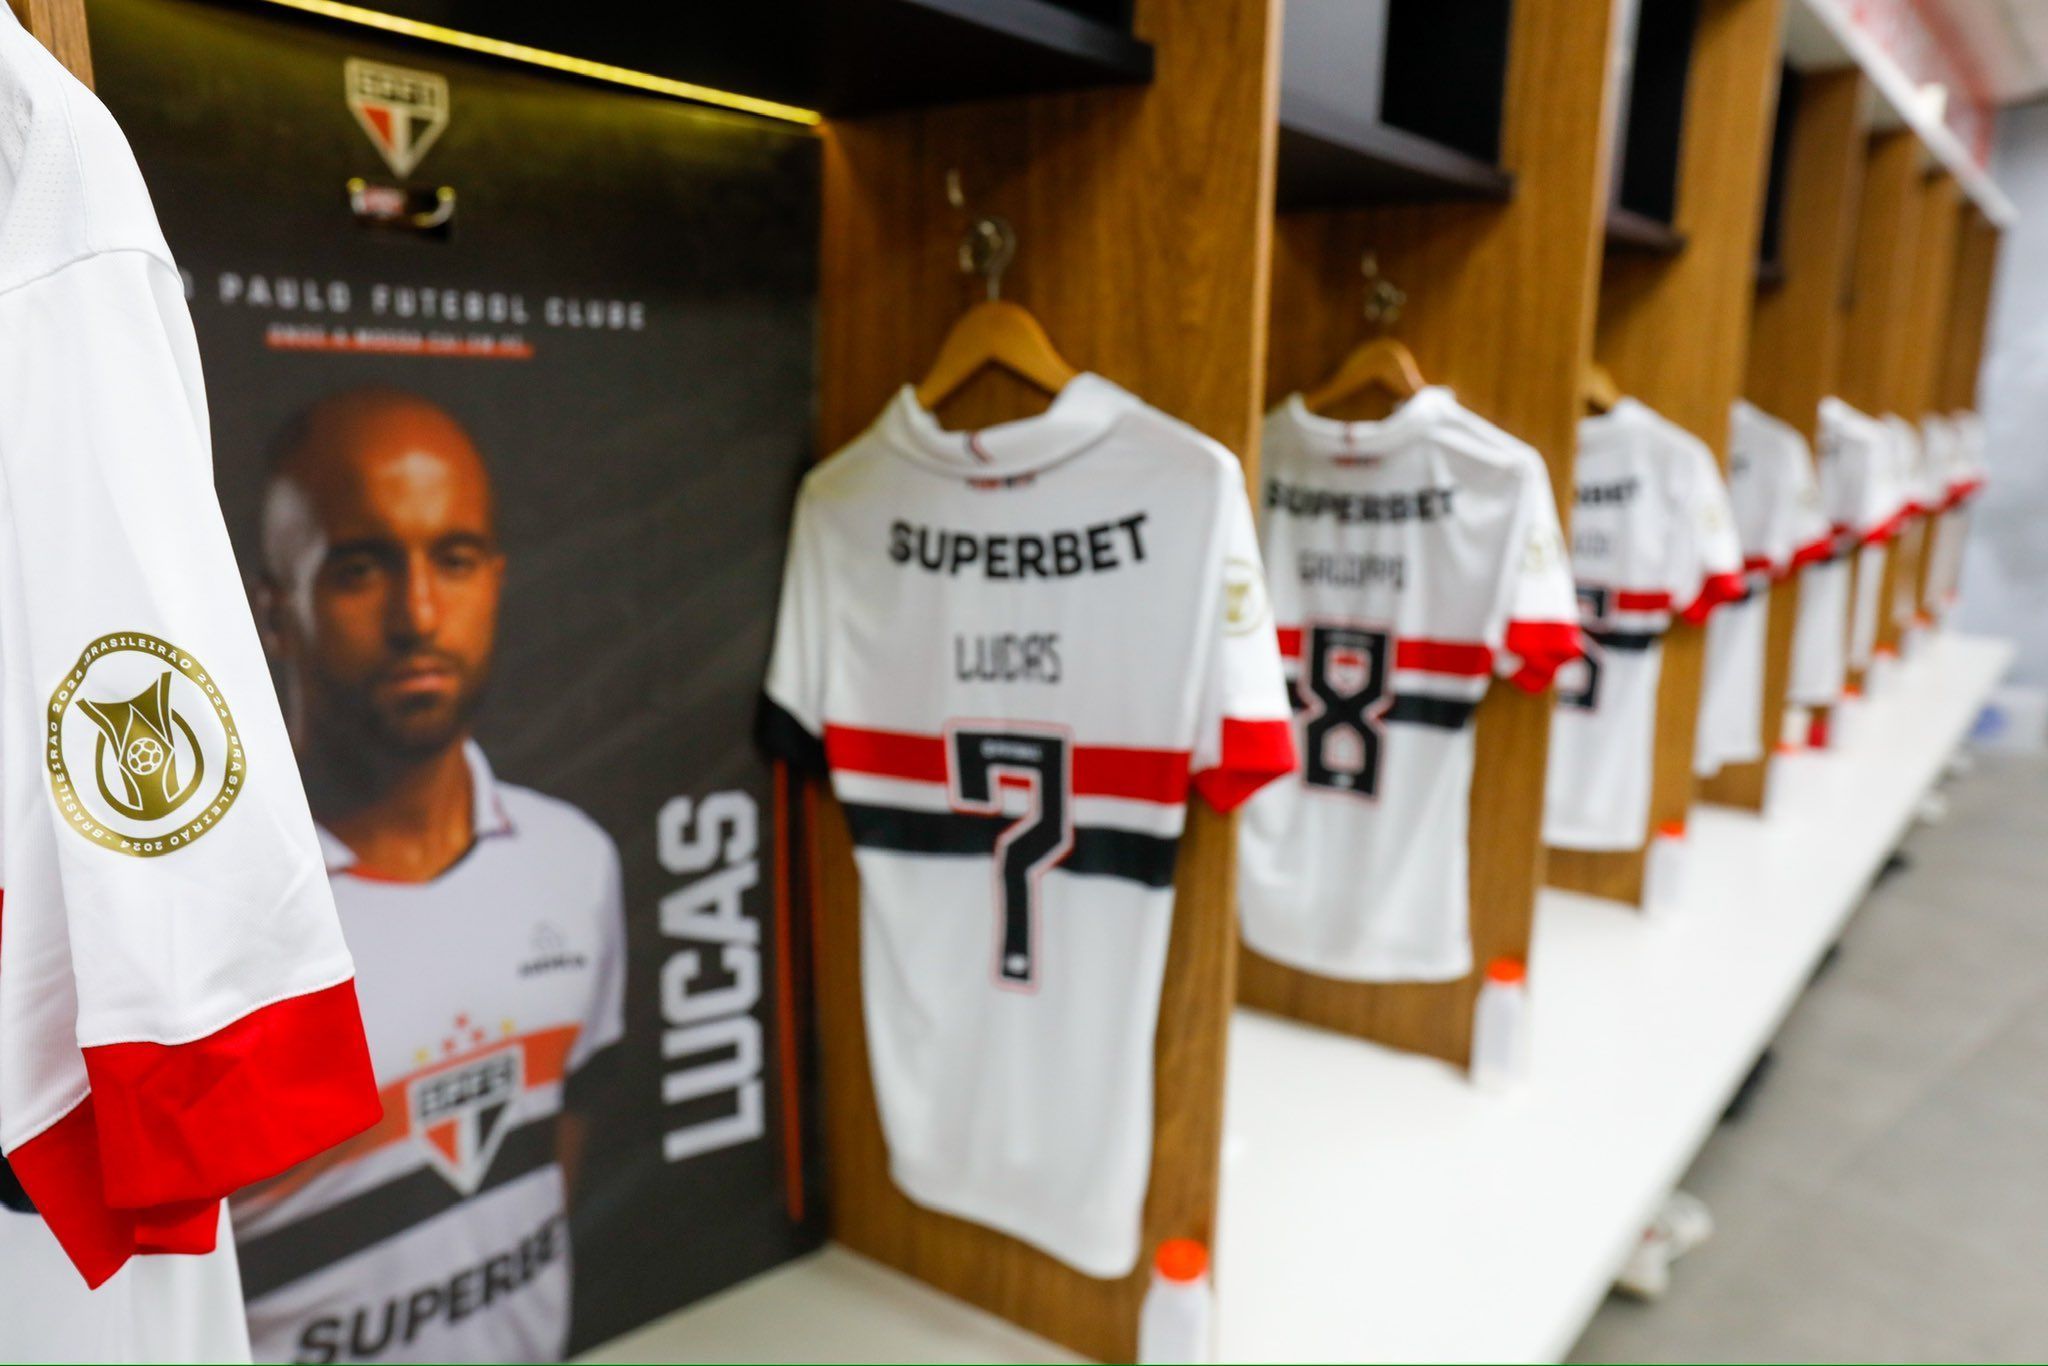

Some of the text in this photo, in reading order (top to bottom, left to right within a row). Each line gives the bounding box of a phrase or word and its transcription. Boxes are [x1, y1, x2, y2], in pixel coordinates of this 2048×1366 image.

[217, 271, 351, 314] PAULO
[370, 283, 529, 326] FUTEBOL
[544, 295, 645, 331] CLUBE
[888, 513, 1149, 580] SUPERBET
[85, 636, 229, 720] BRASILEIRÃO 2024
[955, 632, 1061, 684] LUCAS
[1303, 622, 1393, 801] 8
[48, 668, 104, 840] BRASILEIRÃO 2024
[119, 734, 243, 852] BRASILEIRÃO 2024
[949, 722, 1071, 987] 7
[657, 789, 764, 1163] LUCAS
